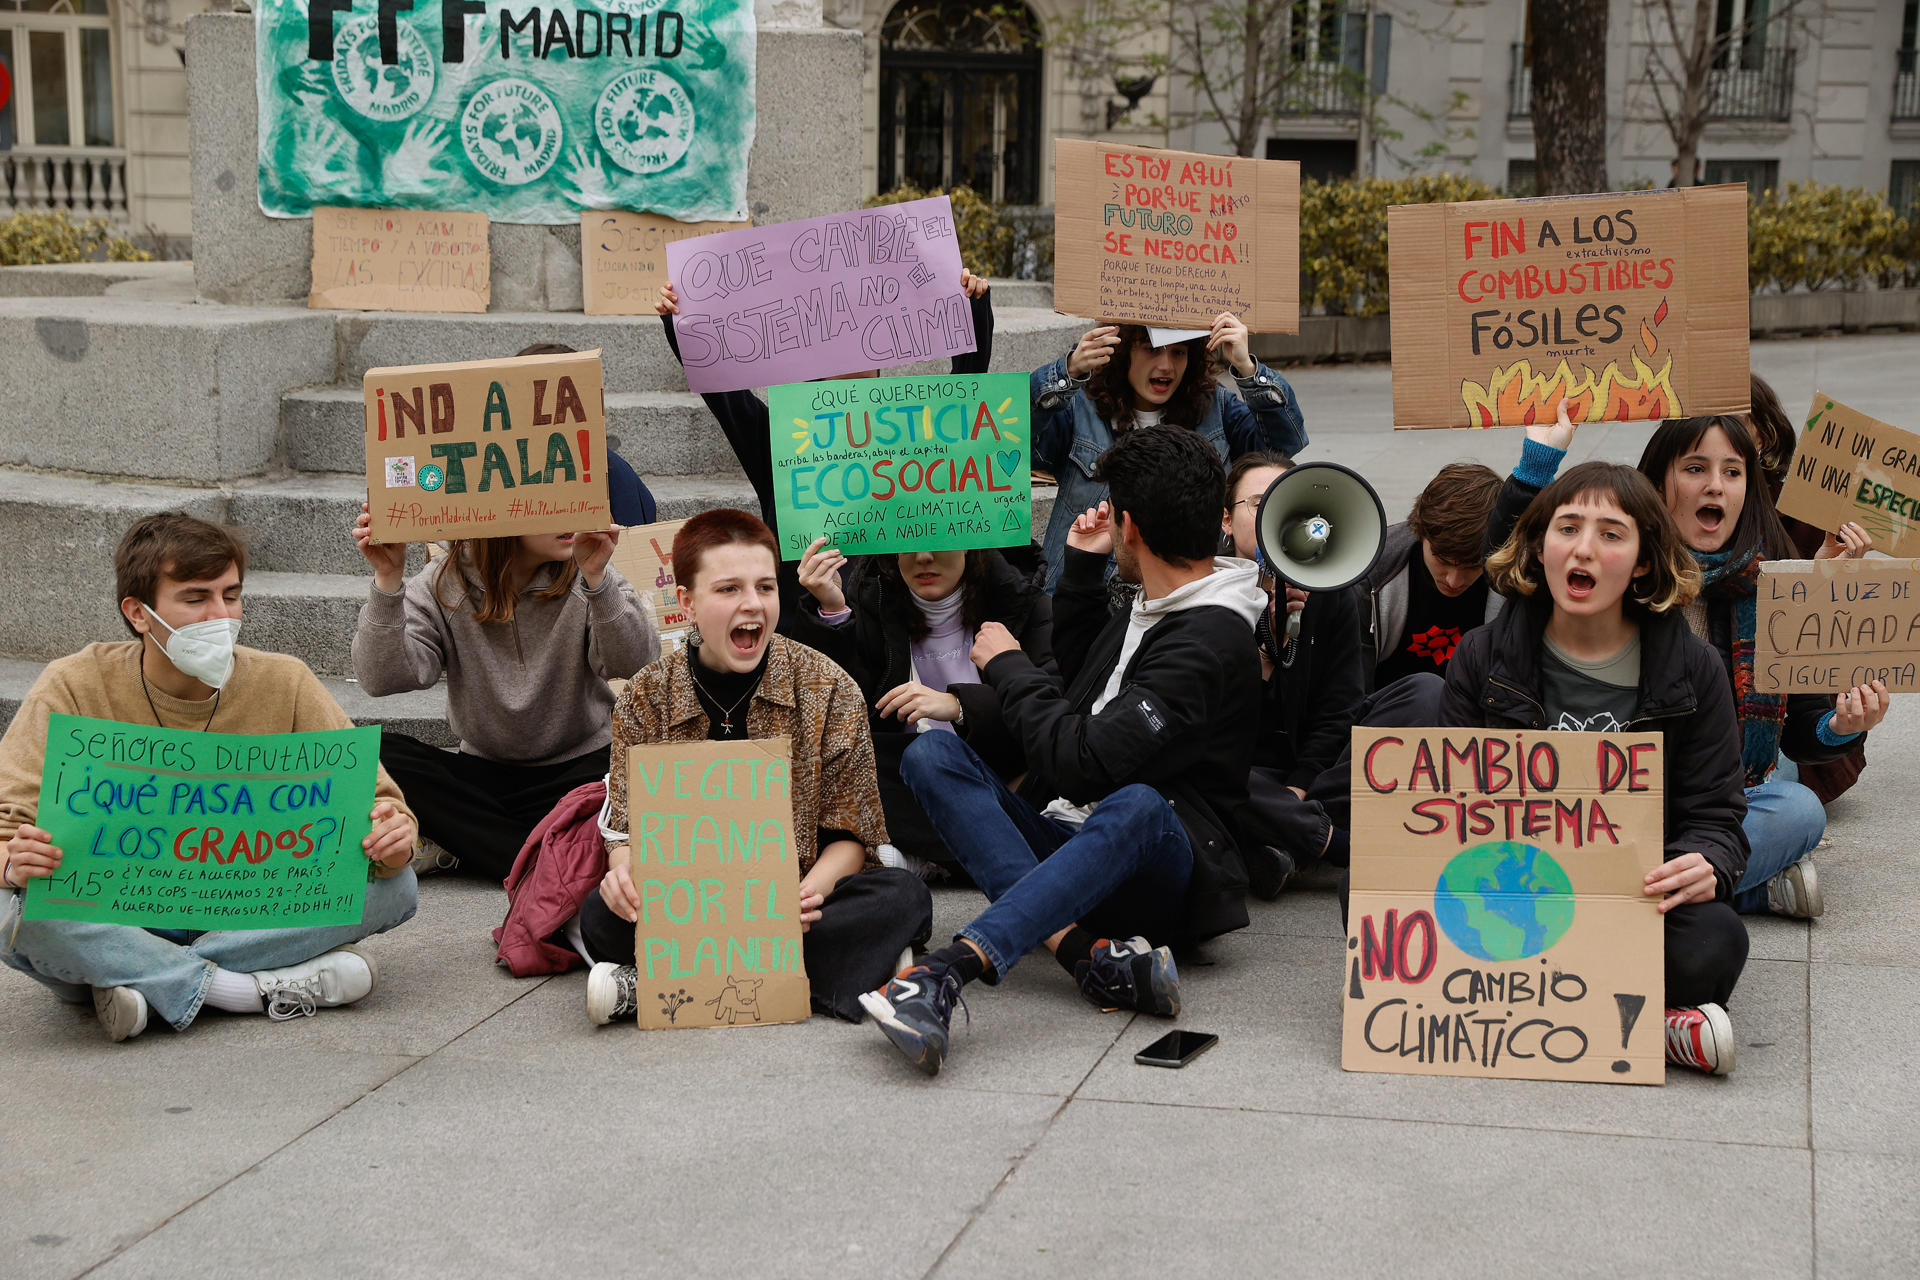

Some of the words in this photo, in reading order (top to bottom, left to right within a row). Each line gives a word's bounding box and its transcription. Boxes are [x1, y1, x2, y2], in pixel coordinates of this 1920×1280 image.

[400, 27, 430, 78] UTURE
[500, 7, 683, 60] MADRID
[369, 91, 420, 115] MADRID
[469, 92, 494, 121] FOR
[466, 124, 507, 180] FRIDAYS
[523, 128, 557, 177] MADRID
[1103, 231, 1133, 256] SE
[1104, 203, 1194, 237] FUTURO
[1203, 220, 1238, 242] NO
[1465, 218, 1526, 260] FIN
[1538, 220, 1561, 247] A
[1573, 210, 1637, 245] LOS
[681, 240, 772, 301] QUE
[922, 216, 952, 240] EL
[1103, 258, 1140, 272] PORQUE
[1175, 265, 1216, 279] DERECHO
[1221, 269, 1228, 280] A
[859, 275, 900, 306] NO
[907, 263, 935, 289] EL
[483, 381, 512, 432] A
[532, 376, 587, 426] LA
[812, 384, 857, 411] ¿QUÉ
[813, 401, 1001, 449] JUSTICIA
[1851, 432, 1876, 460] UN
[430, 430, 591, 494] TALA!
[778, 456, 809, 468] arriba
[812, 451, 824, 463] las
[872, 448, 896, 460] abajo
[913, 444, 948, 456] capital
[1797, 453, 1817, 482] NI
[1821, 464, 1851, 497] UNA
[823, 505, 888, 528] ACCIÓN
[896, 499, 983, 519] CLIMÁTICA
[994, 493, 1026, 508] urgente
[790, 532, 812, 550] SIN
[823, 528, 868, 547] DEJAR
[876, 526, 887, 541] A
[896, 522, 937, 540] NADIE
[947, 517, 991, 536] ATRÁS
[1772, 578, 1807, 603] LA
[1831, 580, 1881, 603] LUZ
[1892, 581, 1911, 599] DE
[1767, 663, 1841, 690] SIGUE
[638, 759, 789, 801] VEGETA
[1597, 740, 1657, 795] DE
[168, 783, 255, 816] PASA
[269, 779, 333, 813] CON
[90, 826, 167, 860] LOS
[640, 812, 786, 866] RIANA
[149, 868, 173, 879] CON
[178, 869, 194, 880] EL
[263, 868, 279, 880] DE
[642, 878, 726, 925] POR
[743, 879, 786, 922] EL
[644, 936, 799, 980] PLANETA
